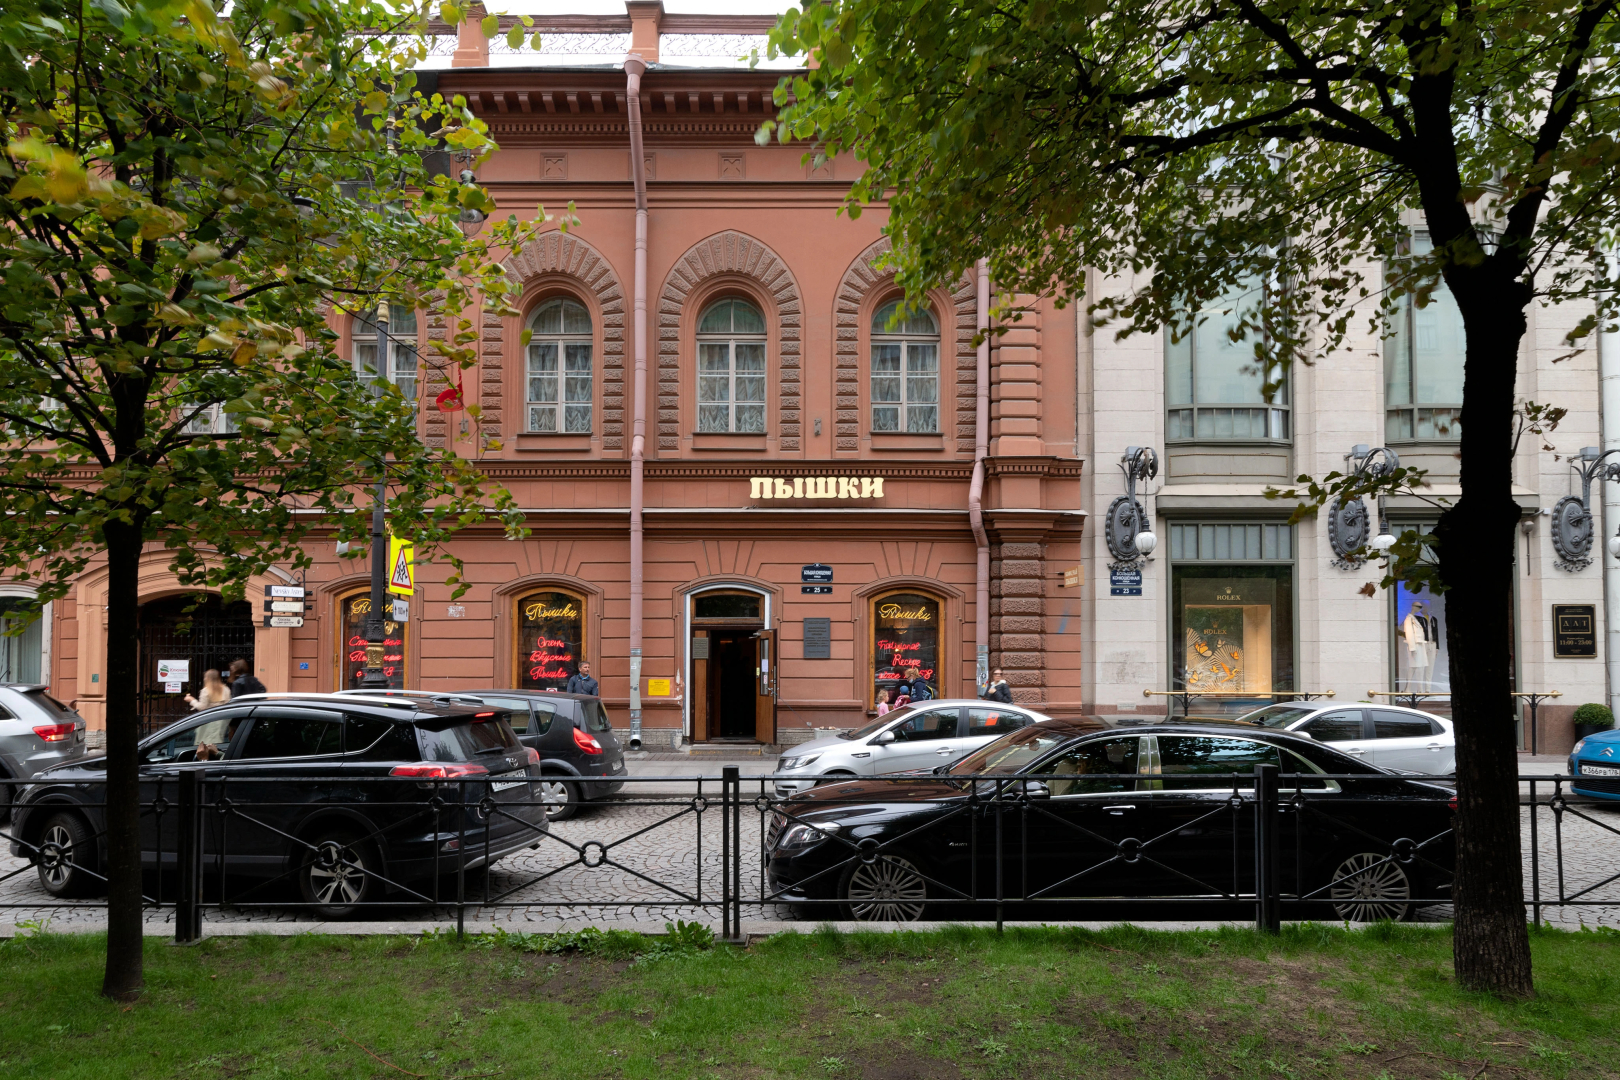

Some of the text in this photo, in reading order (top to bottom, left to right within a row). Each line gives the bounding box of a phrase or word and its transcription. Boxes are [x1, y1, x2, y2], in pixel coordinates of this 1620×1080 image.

[525, 603, 577, 620] Пышки
[881, 603, 932, 620] Пышки
[892, 653, 921, 669] Recipe
[530, 665, 568, 680] Пышки
